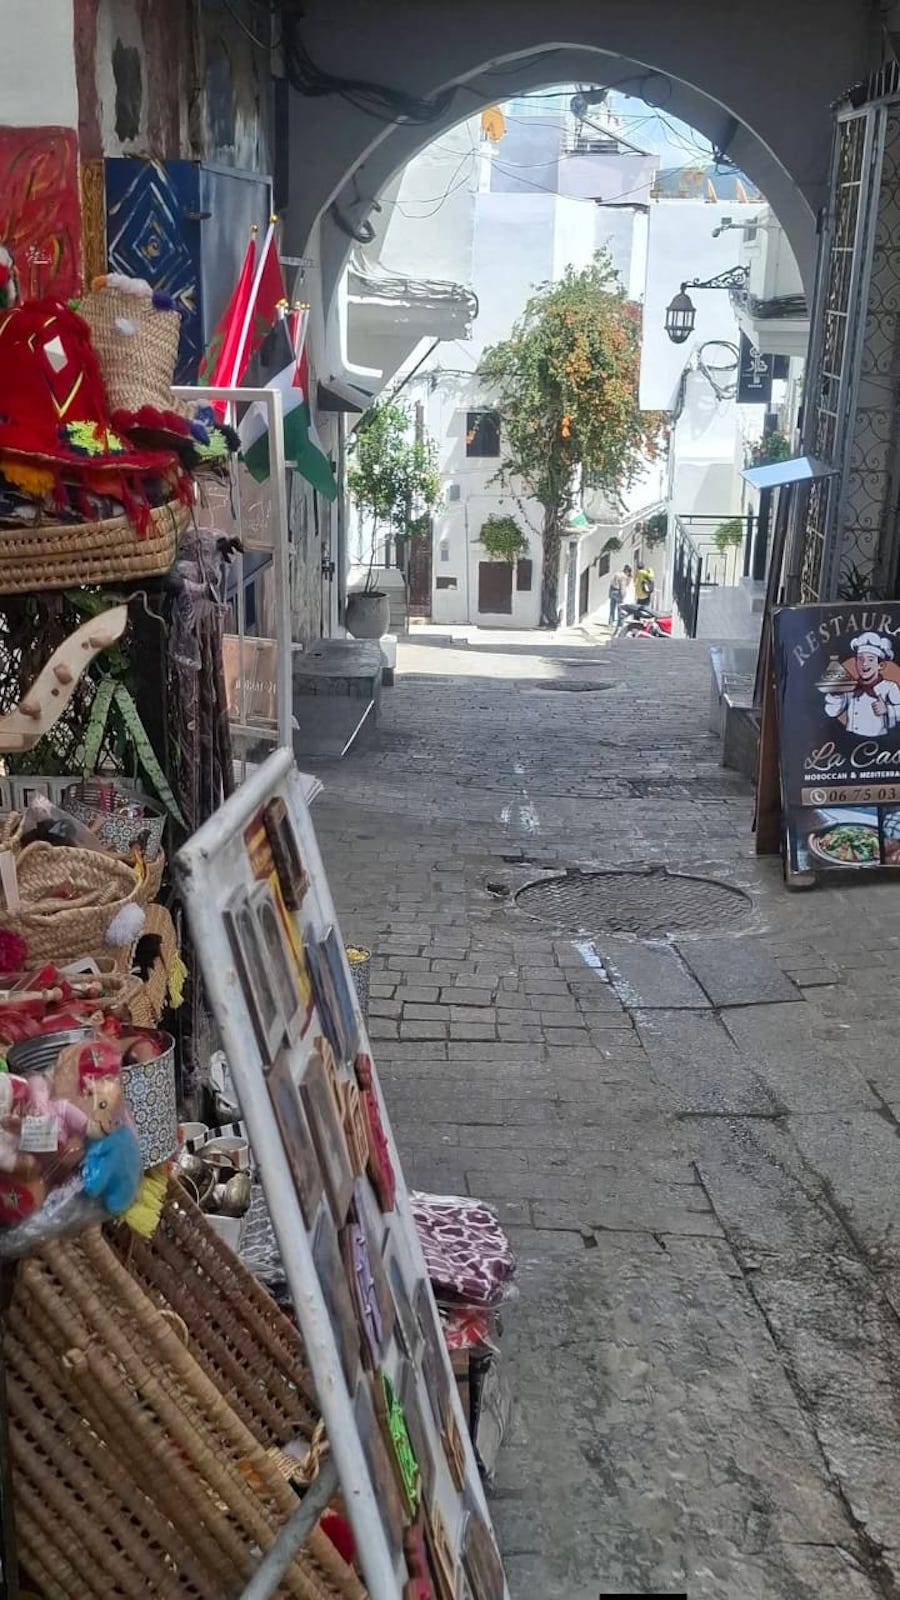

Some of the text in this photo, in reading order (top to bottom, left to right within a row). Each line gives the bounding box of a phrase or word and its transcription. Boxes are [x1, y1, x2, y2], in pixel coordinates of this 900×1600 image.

[793, 612, 900, 667] RESTAUR
[804, 741, 846, 771] La
[804, 772, 847, 781] MOROCCAN
[850, 771, 857, 779] &
[829, 787, 896, 802] 06 75 03
